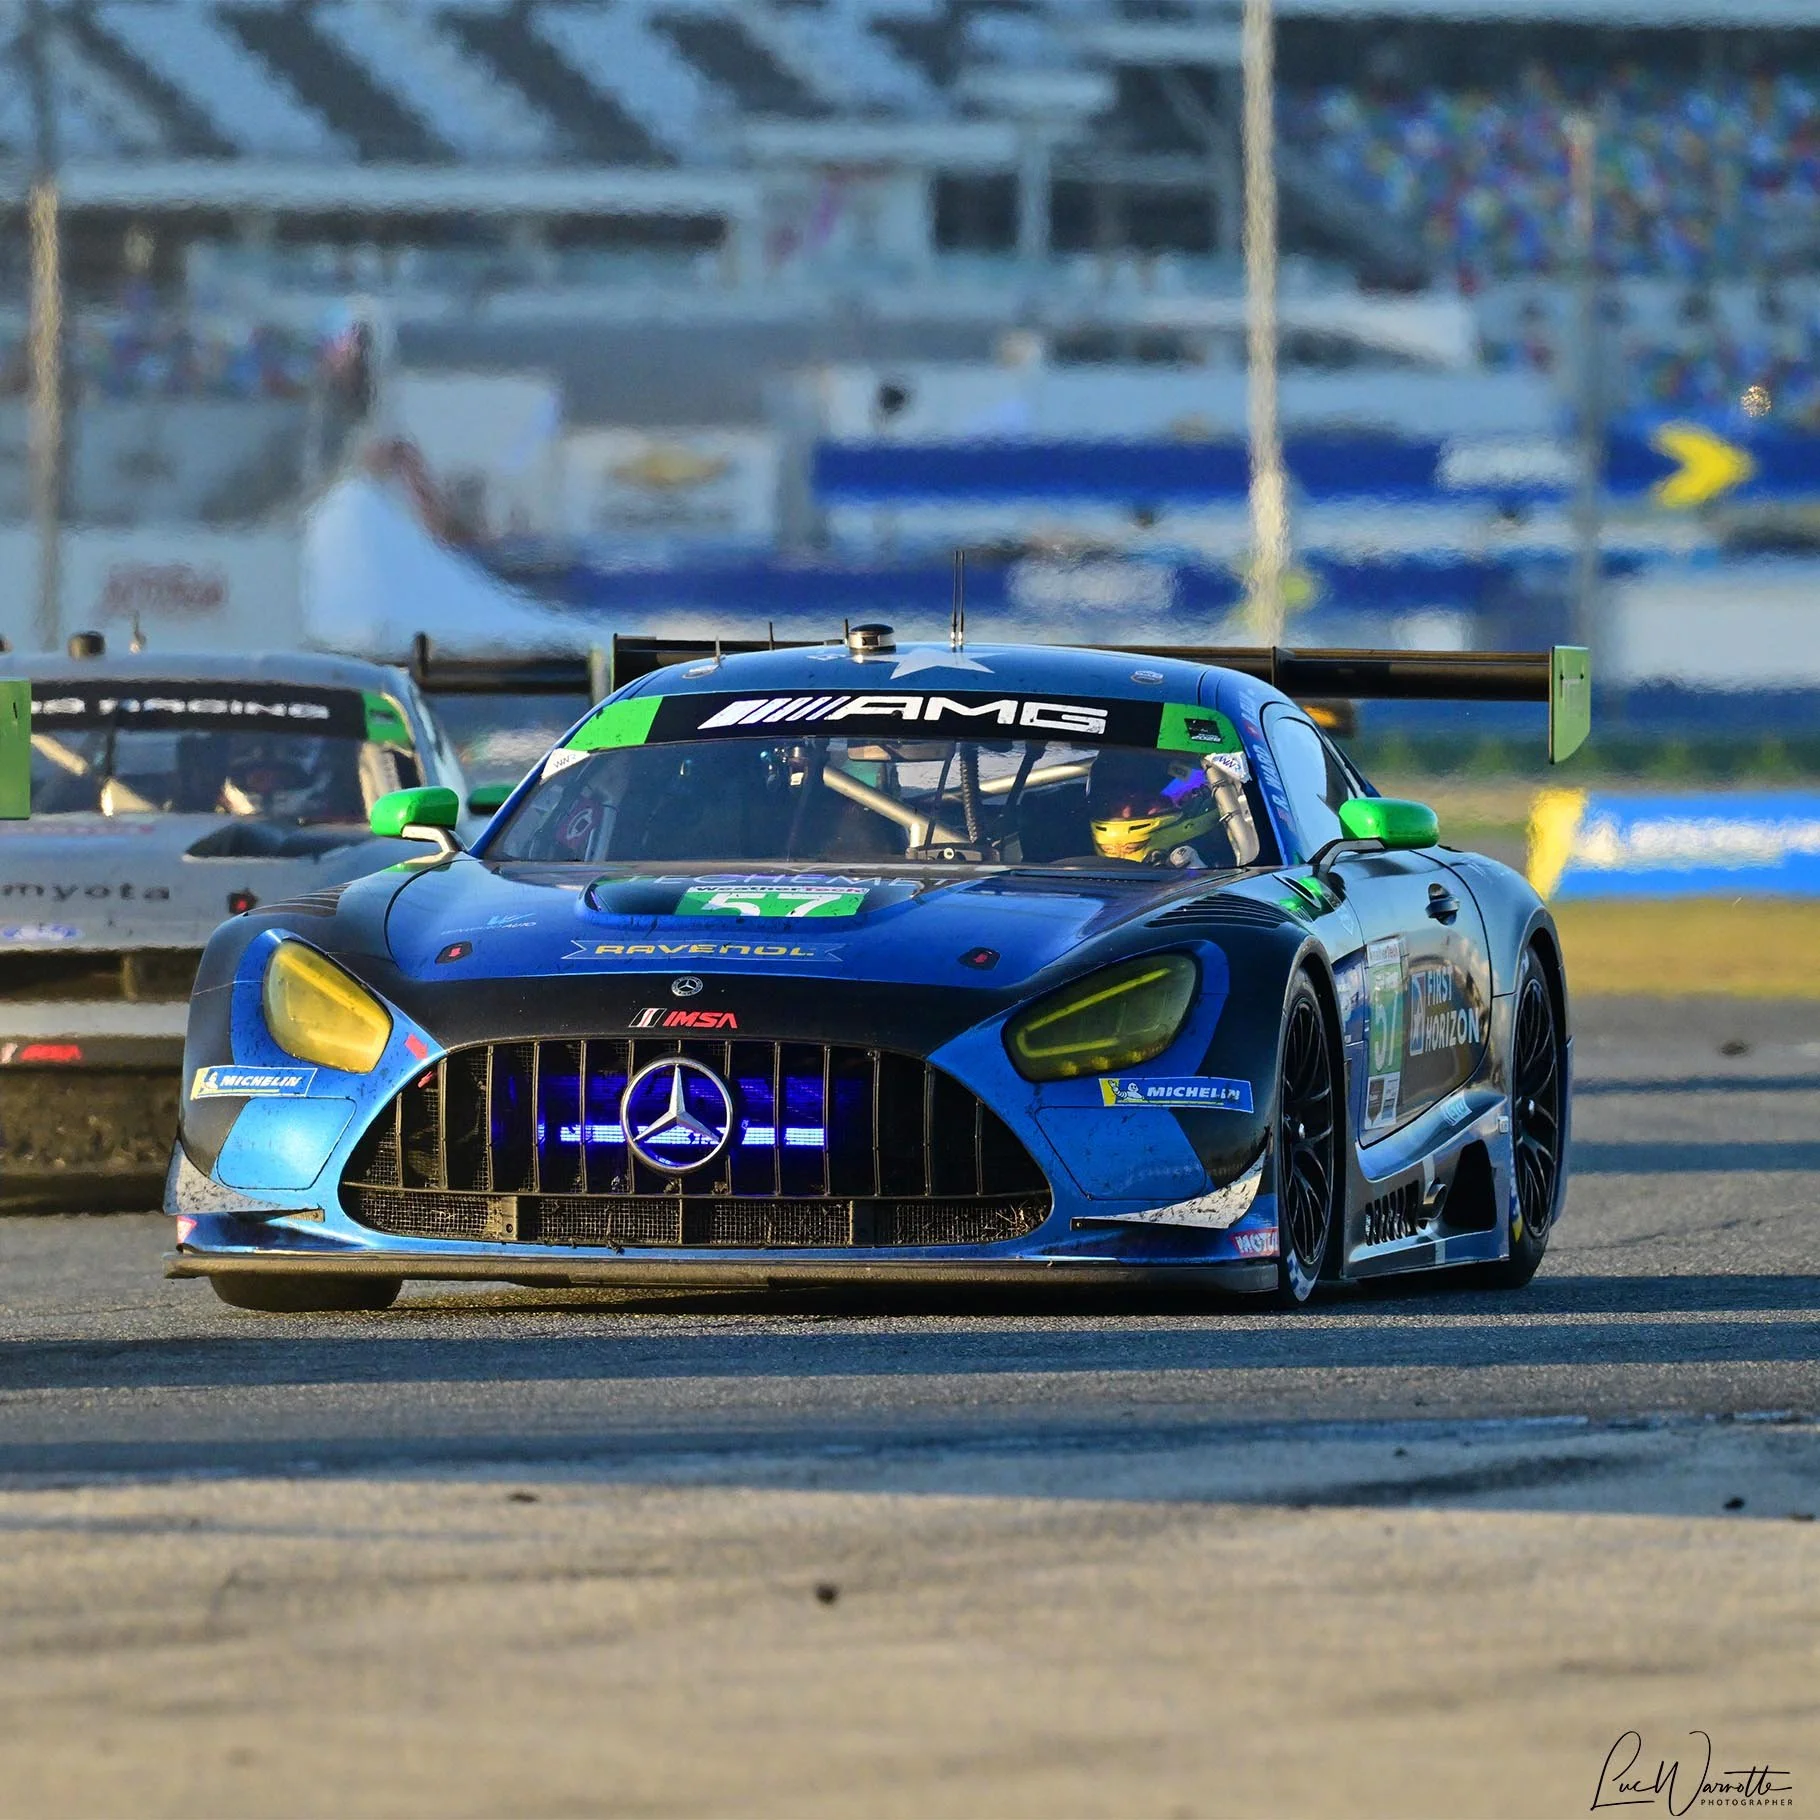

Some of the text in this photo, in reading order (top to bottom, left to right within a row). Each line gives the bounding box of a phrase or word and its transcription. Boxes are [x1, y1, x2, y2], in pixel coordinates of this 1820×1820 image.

[824, 695, 1109, 735] AMG
[696, 884, 867, 895] WeatherTech
[701, 891, 842, 915] 57
[595, 944, 815, 957] RAVENOL
[1426, 964, 1454, 1007] FIRST
[662, 1010, 739, 1029] IMSA
[1424, 1007, 1481, 1053] HORIZON
[219, 1075, 304, 1088] MICHELIN
[1146, 1086, 1241, 1101] MICHELIN
